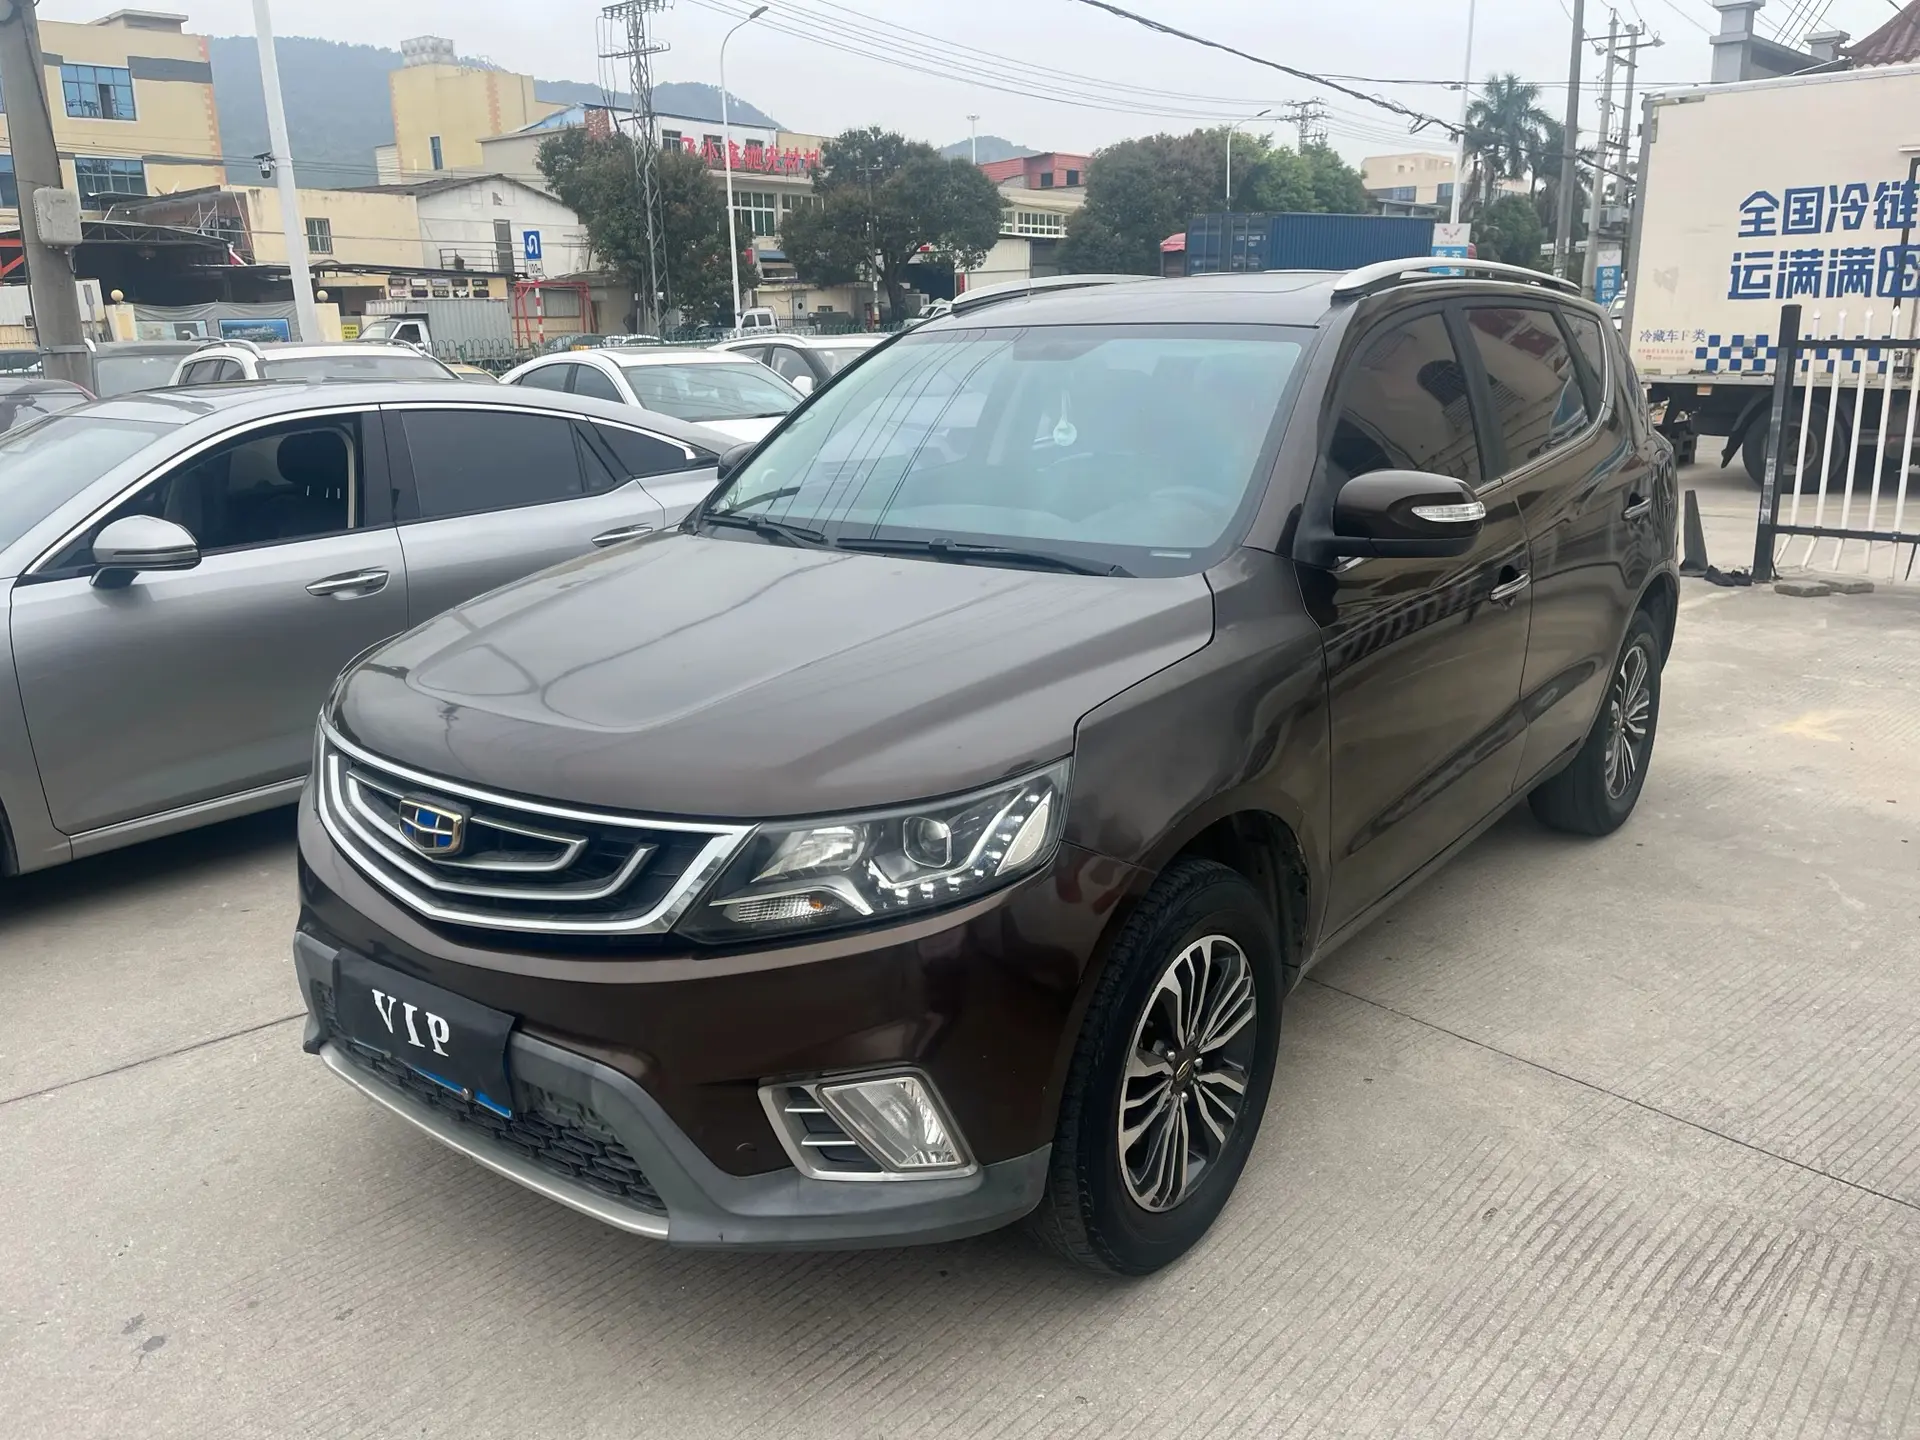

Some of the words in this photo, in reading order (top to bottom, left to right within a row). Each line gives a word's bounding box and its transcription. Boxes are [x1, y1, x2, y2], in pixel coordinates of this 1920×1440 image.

[1738, 181, 1919, 237] 全国冷链
[371, 988, 450, 1057] VIP
